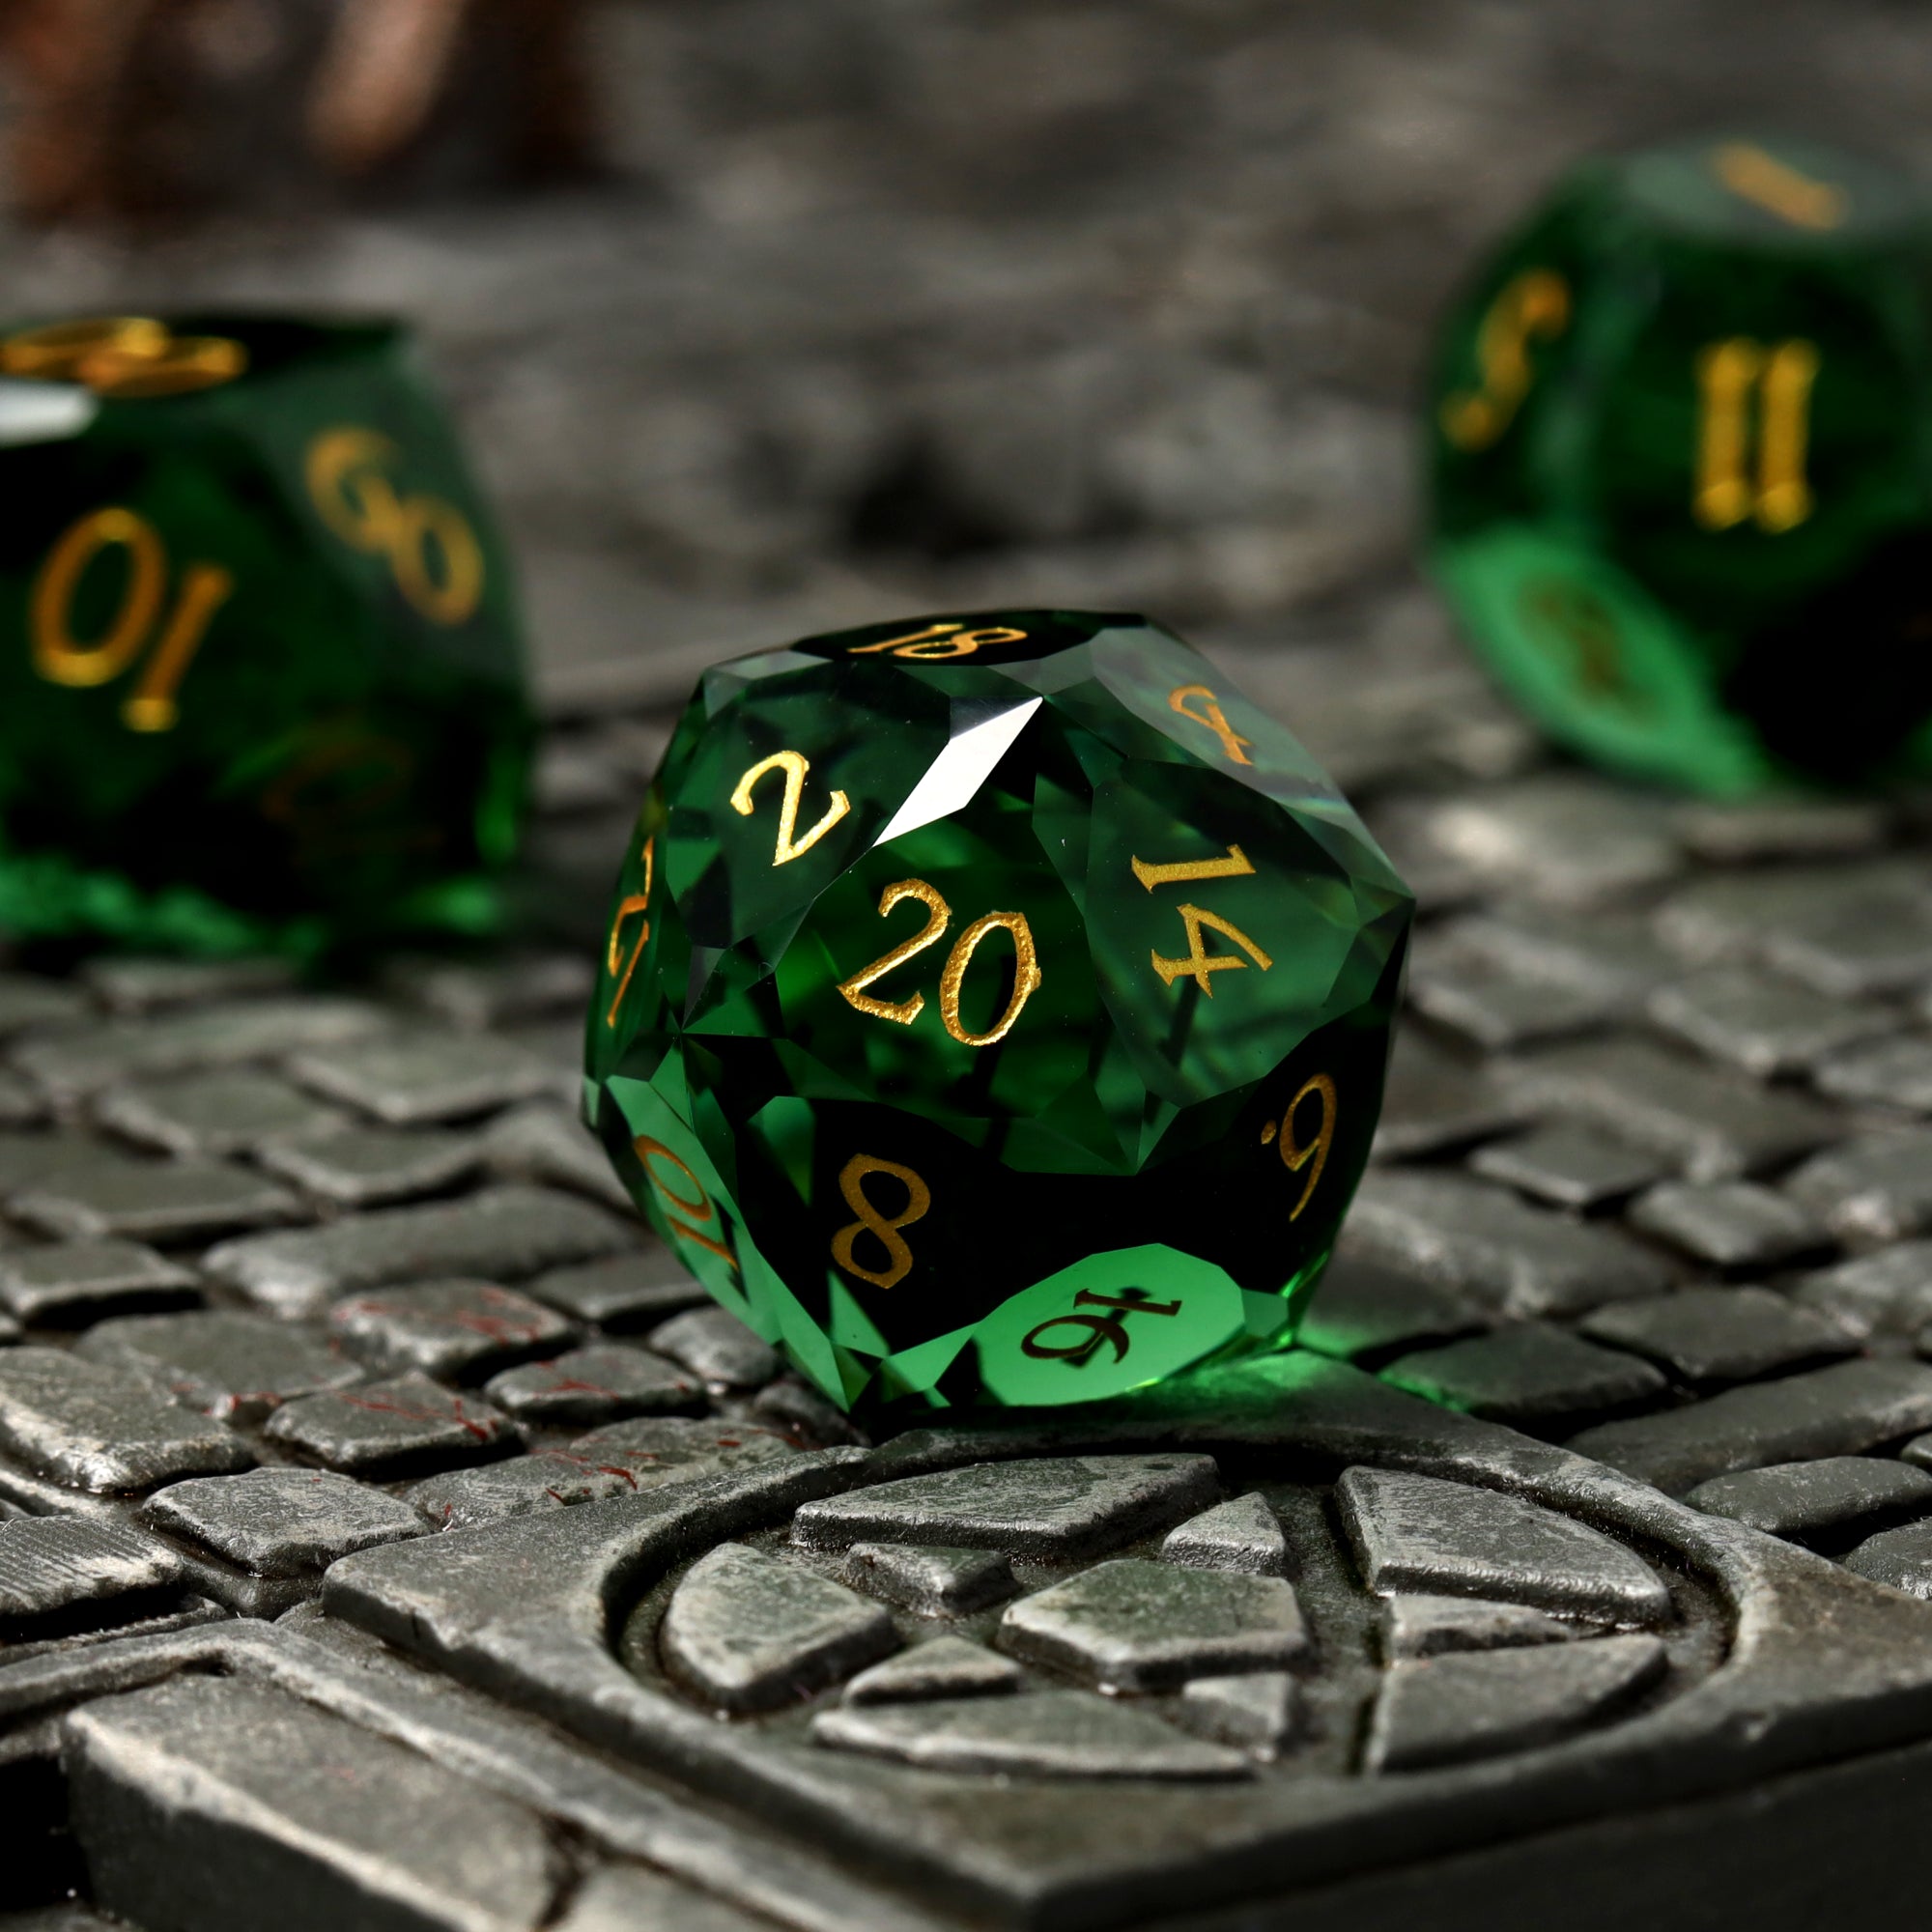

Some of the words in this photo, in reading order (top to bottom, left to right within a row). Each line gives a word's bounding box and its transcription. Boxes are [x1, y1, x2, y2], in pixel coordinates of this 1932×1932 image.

[731, 751, 851, 866] 2
[837, 878, 1042, 1047] 20
[1130, 842, 1273, 999] 14
[831, 1152, 931, 1291] 8
